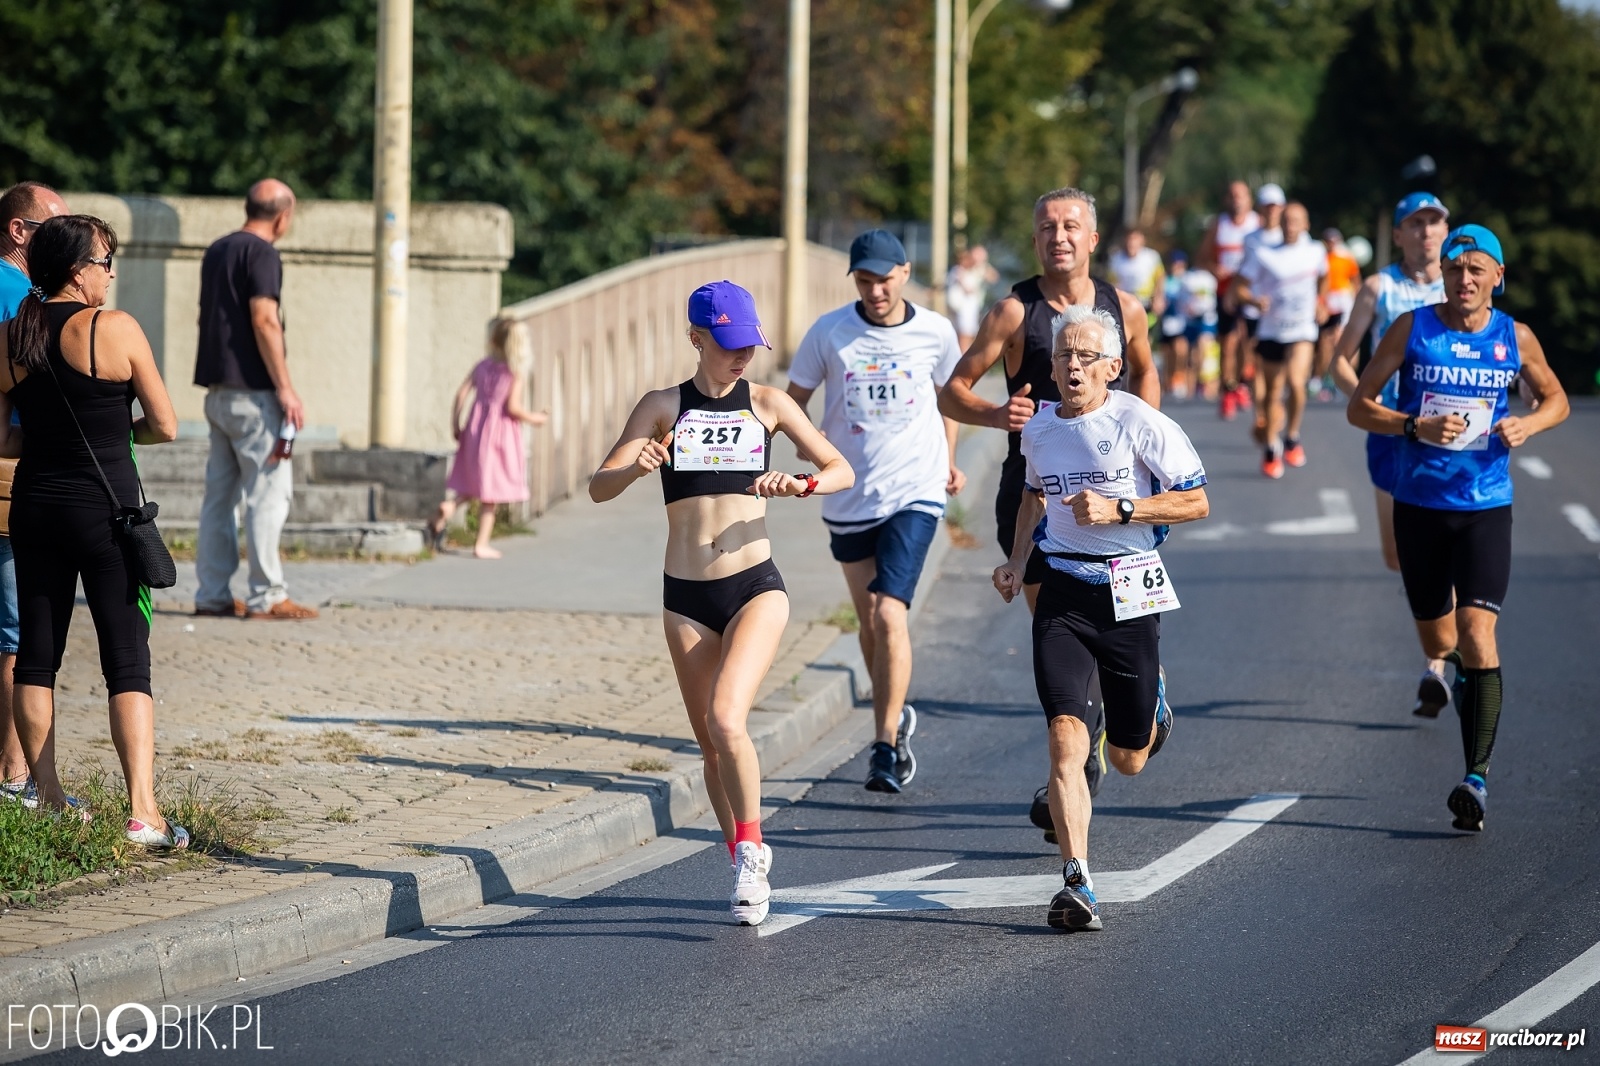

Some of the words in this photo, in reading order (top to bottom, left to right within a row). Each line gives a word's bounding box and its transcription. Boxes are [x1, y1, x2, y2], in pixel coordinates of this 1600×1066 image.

[1413, 363, 1515, 388] RUNNERS
[868, 384, 896, 400] 121
[1477, 390, 1499, 398] TEAM
[701, 426, 742, 444] 257
[1143, 567, 1165, 589] 63
